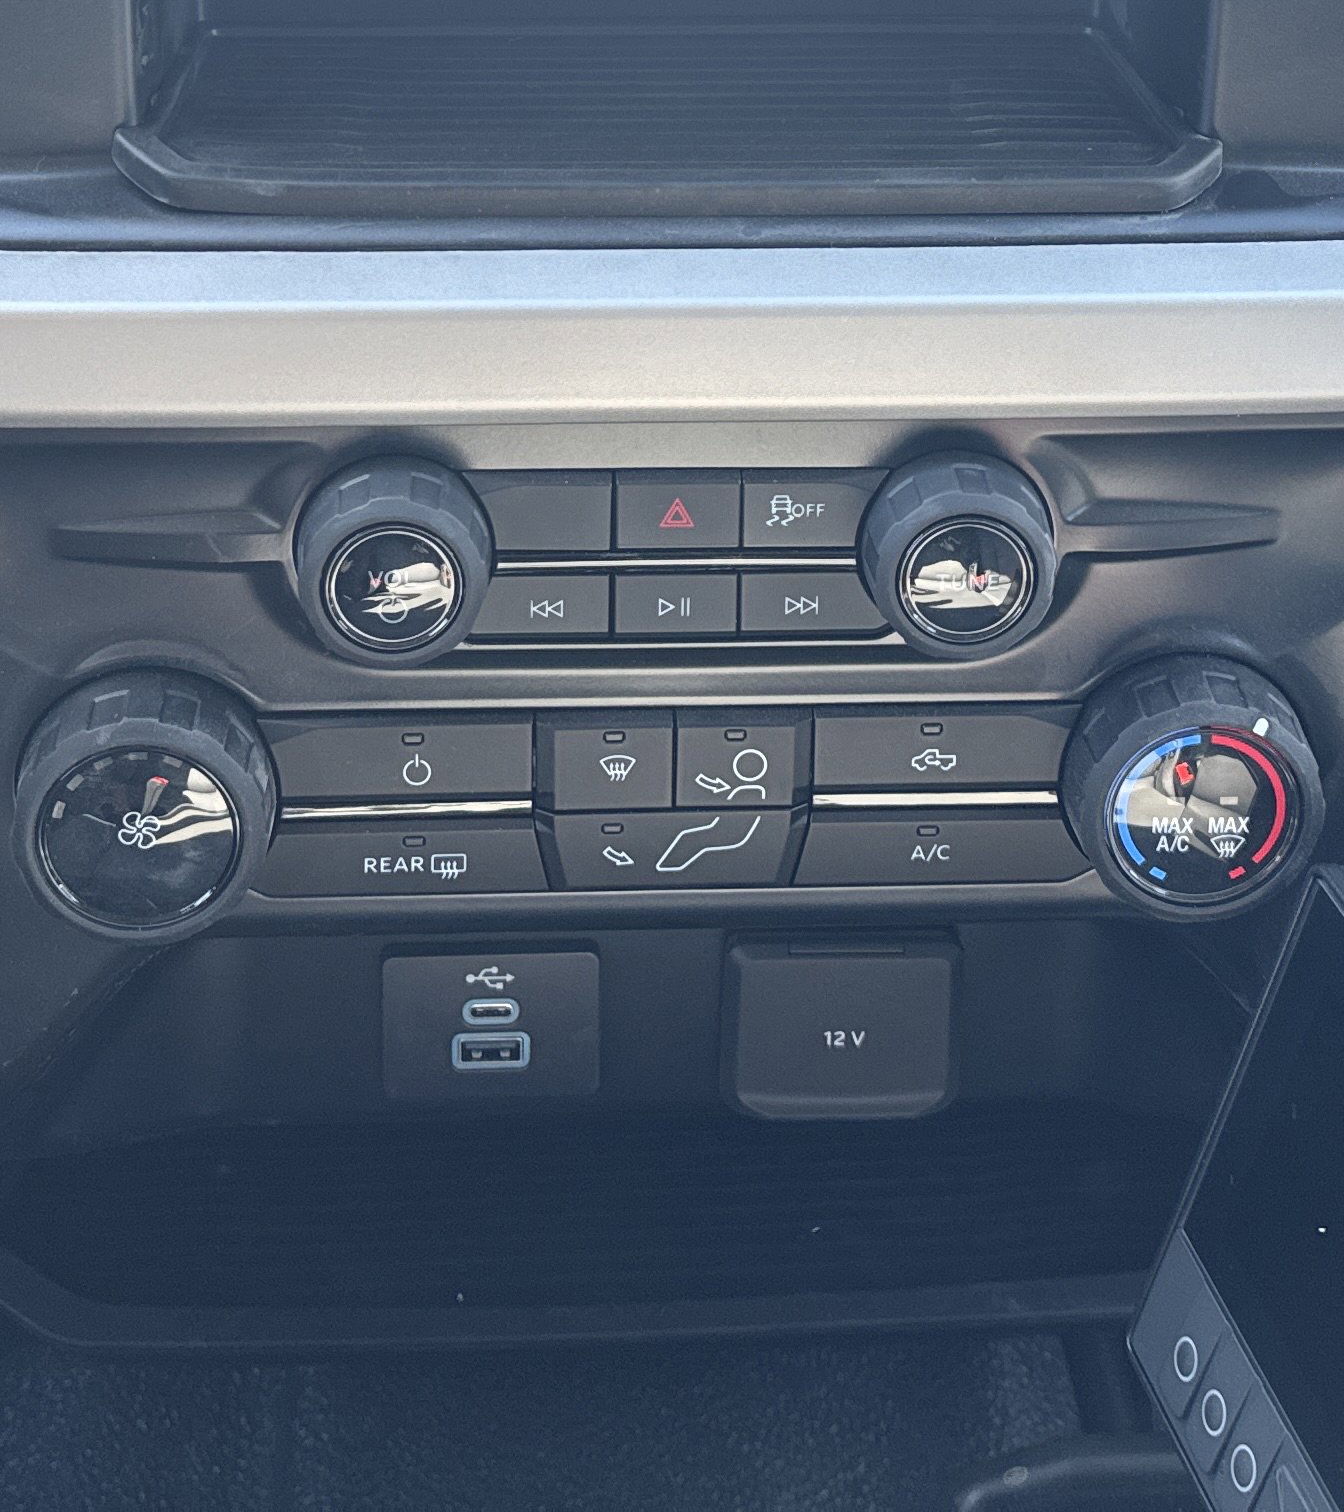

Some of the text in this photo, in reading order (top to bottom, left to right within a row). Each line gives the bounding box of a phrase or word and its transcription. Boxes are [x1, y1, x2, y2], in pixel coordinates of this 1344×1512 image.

[791, 503, 826, 518] OFF
[935, 572, 1001, 592] TUNE
[1151, 816, 1194, 834] MAX
[1207, 816, 1250, 834] MAX
[910, 843, 950, 862] A/C
[1155, 834, 1190, 853] A/C
[364, 856, 425, 874] REAR
[823, 1030, 865, 1047] 12 V
